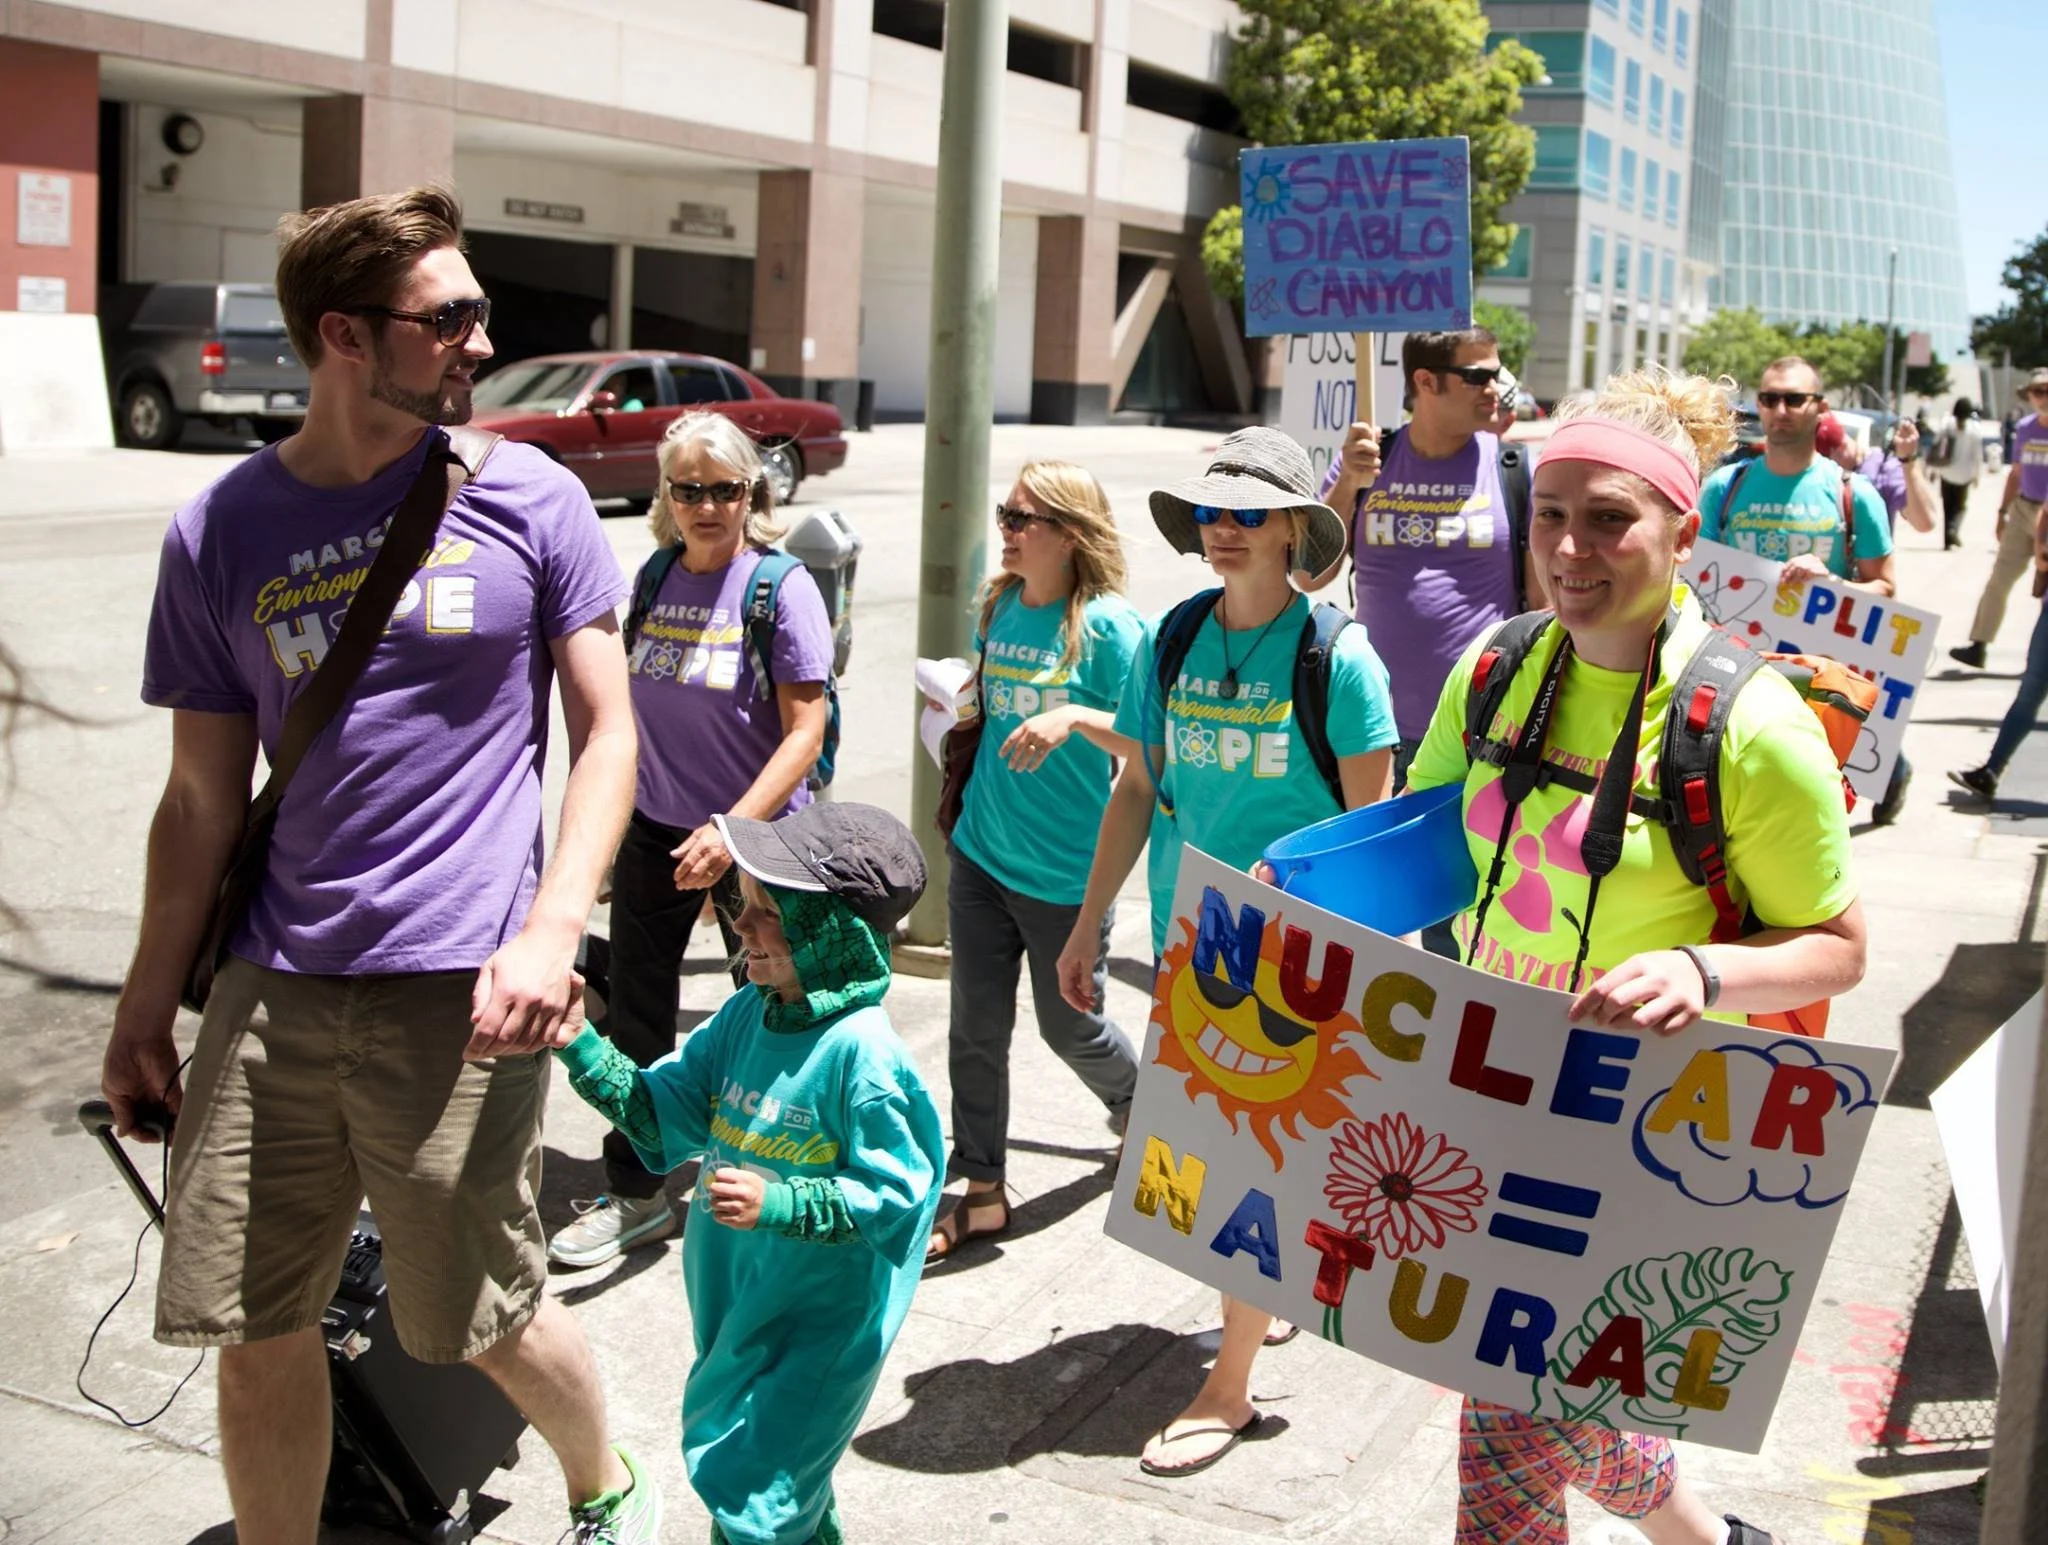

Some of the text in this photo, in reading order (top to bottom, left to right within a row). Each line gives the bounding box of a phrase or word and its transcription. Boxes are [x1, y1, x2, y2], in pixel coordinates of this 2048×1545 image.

[1287, 147, 1443, 214] SAVE
[1267, 211, 1454, 263] DIABLO
[1286, 265, 1455, 318] CANYON
[1388, 478, 1456, 497] MARCH
[289, 516, 393, 576] MARC
[265, 576, 475, 679] HPE
[652, 604, 712, 624] MARCH
[1772, 582, 1923, 657] SPLIT
[1526, 680, 1556, 749] DIGITAL
[1191, 885, 1838, 1157] NUCLEAR
[783, 1110, 813, 1126] FOR
[1133, 1134, 1732, 1412] NATURAL
